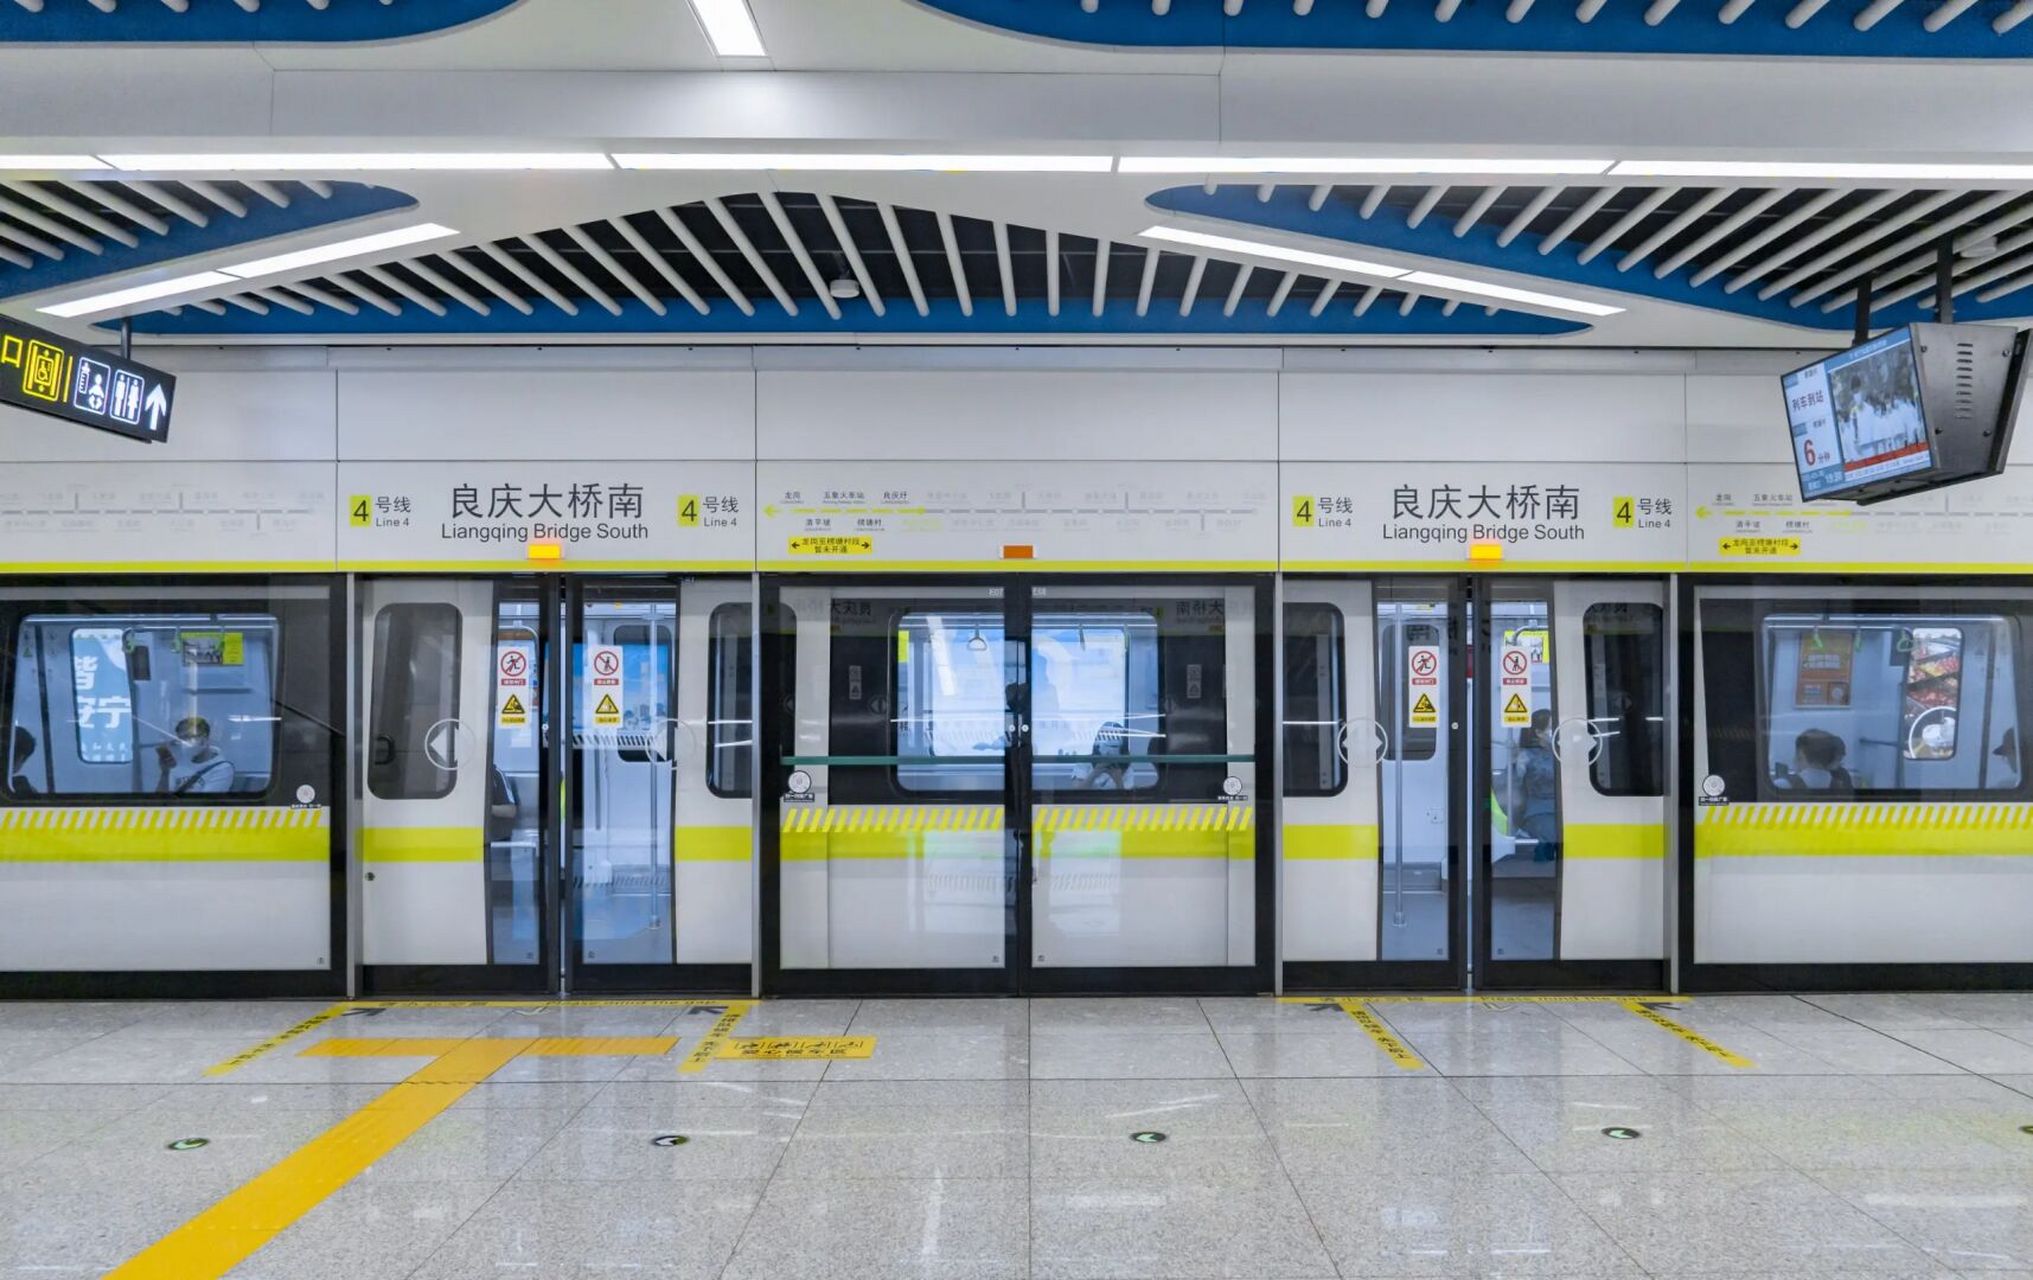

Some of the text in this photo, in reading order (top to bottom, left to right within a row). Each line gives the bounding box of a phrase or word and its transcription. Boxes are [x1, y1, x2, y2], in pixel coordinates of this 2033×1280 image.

[1803, 439, 1816, 467] 6
[352, 499, 370, 523] 4
[375, 496, 411, 514] 号线
[452, 482, 644, 519] 良庆大桥南
[680, 499, 698, 523] 4
[702, 496, 739, 514] 号线
[1318, 497, 1353, 514] 号线
[1393, 483, 1580, 520] 良庆大桥南
[1638, 498, 1672, 515] 号线
[703, 517, 737, 527] Line 4
[1296, 500, 1313, 523] 4
[1615, 500, 1632, 524] 4
[375, 518, 409, 527] Line 4
[441, 522, 648, 543] Liangqing Bridge South
[1318, 518, 1352, 527] Line 4
[1638, 519, 1671, 528] Line 4
[1383, 523, 1585, 544] Liangqing Bridge South
